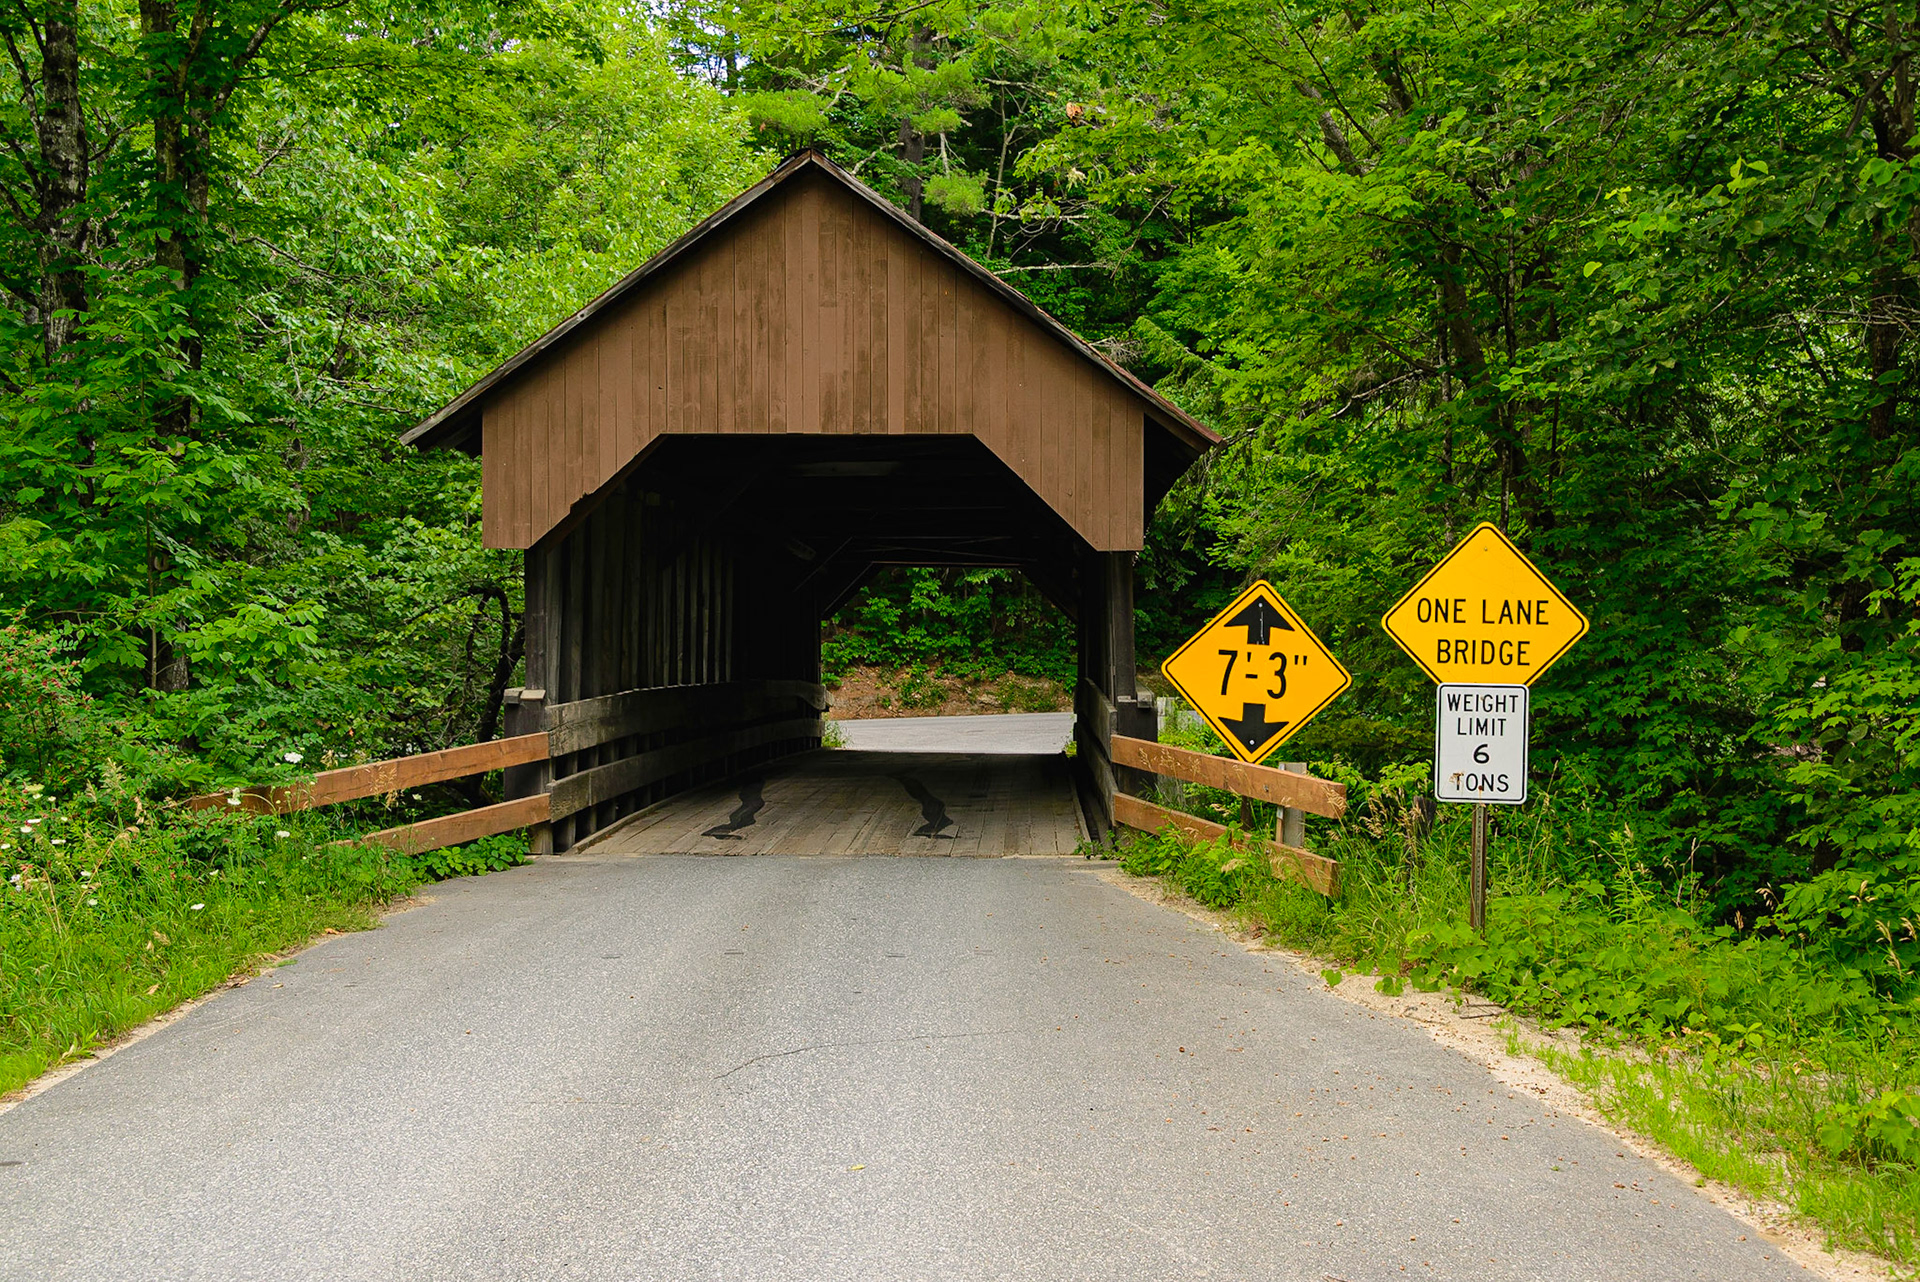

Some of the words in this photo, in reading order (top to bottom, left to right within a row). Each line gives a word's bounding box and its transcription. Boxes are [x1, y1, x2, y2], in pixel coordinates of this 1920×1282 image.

[1416, 597, 1467, 625] ONE
[1482, 598, 1549, 626] LANE
[1436, 638, 1531, 666] BRIDGE
[1447, 693, 1519, 713] WEIGHT
[1457, 717, 1507, 737] LIMIT
[1473, 743, 1490, 764] 6
[1453, 772, 1510, 793] TONS
